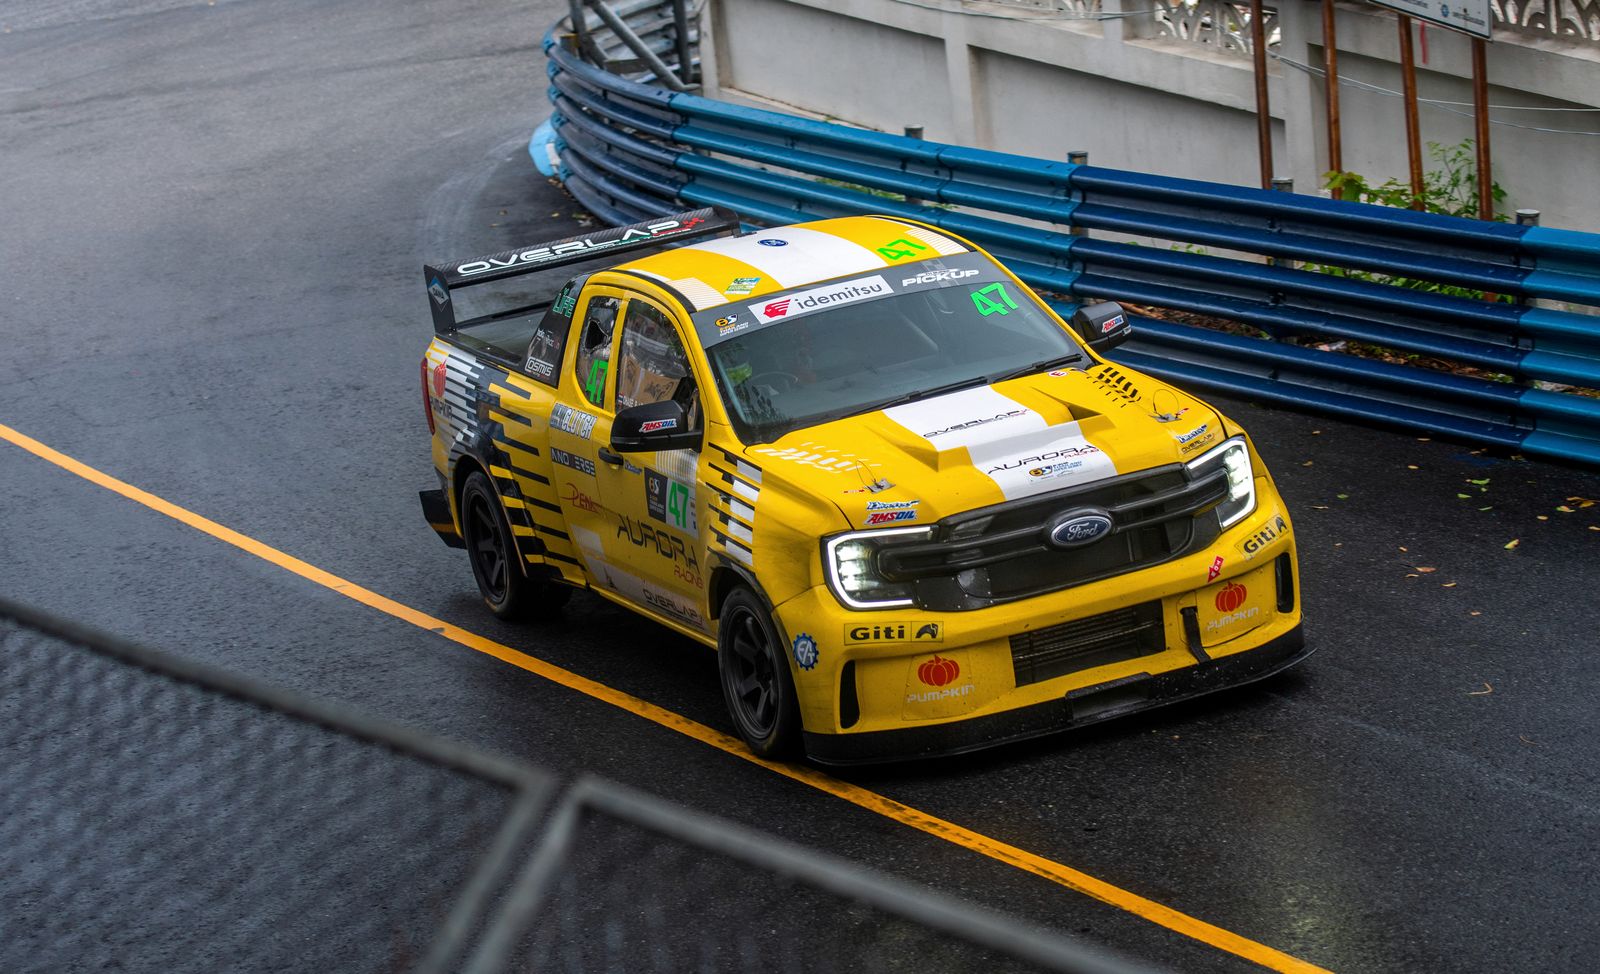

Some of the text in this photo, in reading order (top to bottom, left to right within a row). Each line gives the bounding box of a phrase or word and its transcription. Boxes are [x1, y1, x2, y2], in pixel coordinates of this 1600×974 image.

[457, 220, 680, 274] OVERLAP
[876, 238, 927, 260] 47
[902, 269, 980, 287] PICKUP
[795, 283, 883, 310] idemitsu
[970, 282, 1019, 317] 47
[585, 358, 609, 404] 47
[642, 419, 676, 431] AMSOIL
[923, 409, 1021, 438] OVERLAP
[987, 444, 1099, 475] AURORA
[668, 480, 689, 529] 47
[866, 510, 916, 525] AMSOIL
[617, 512, 701, 575] AURORA
[1067, 521, 1099, 541] Ford
[1243, 526, 1276, 554] Giti
[643, 588, 698, 618] OVERLAP
[850, 625, 905, 640] Giti
[1207, 606, 1259, 632] PUMPKIN
[907, 683, 976, 704] PUMPKIN
